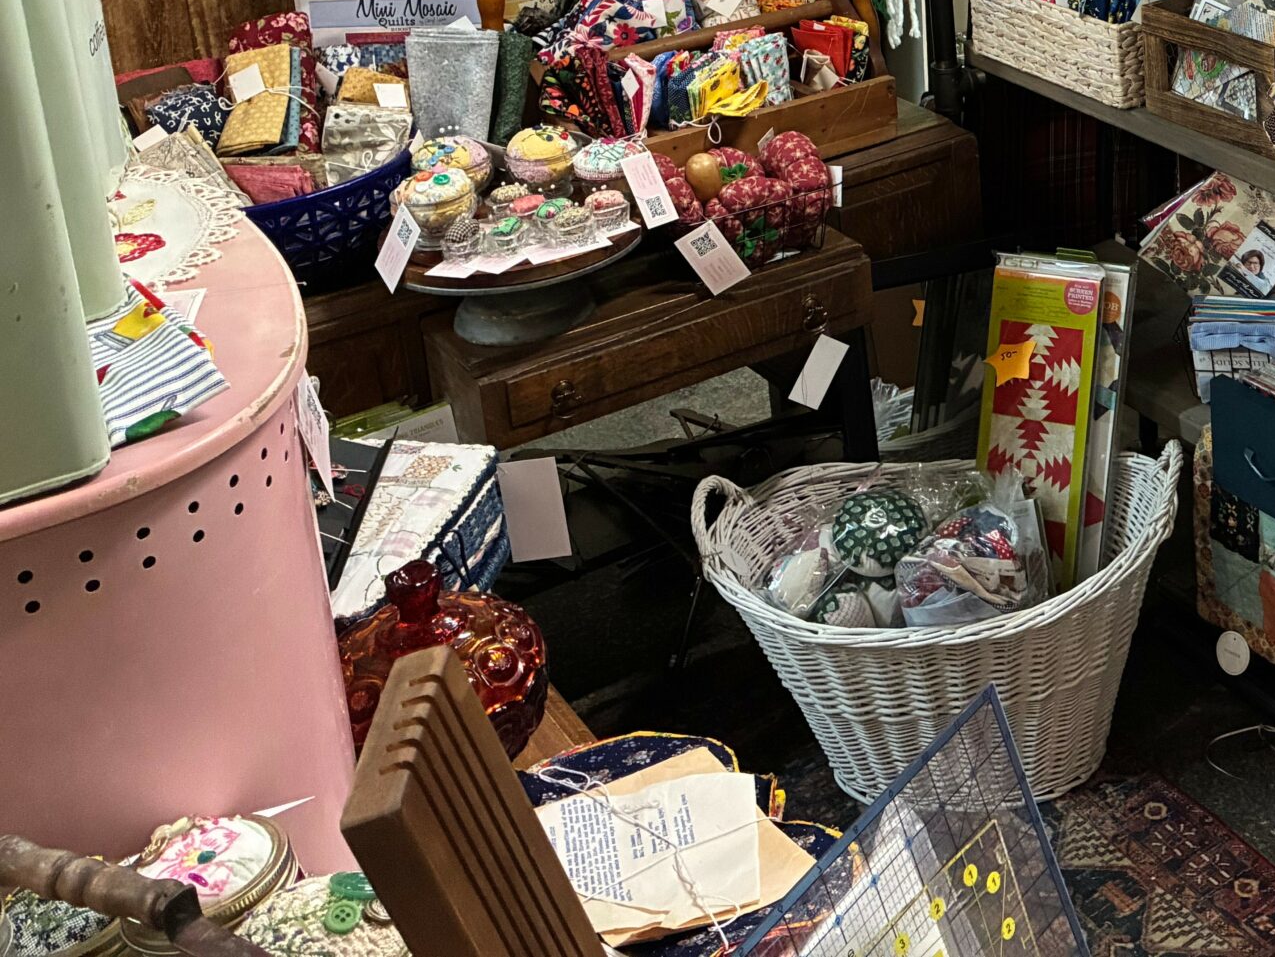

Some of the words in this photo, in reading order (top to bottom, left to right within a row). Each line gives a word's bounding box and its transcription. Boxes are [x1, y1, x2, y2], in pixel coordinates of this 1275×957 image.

[378, 17, 416, 28] Quilts
[967, 870, 974, 880] 1
[991, 876, 997, 886] 1
[934, 903, 941, 915] 2
[1005, 923, 1012, 933] 2
[899, 939, 906, 950] 3
